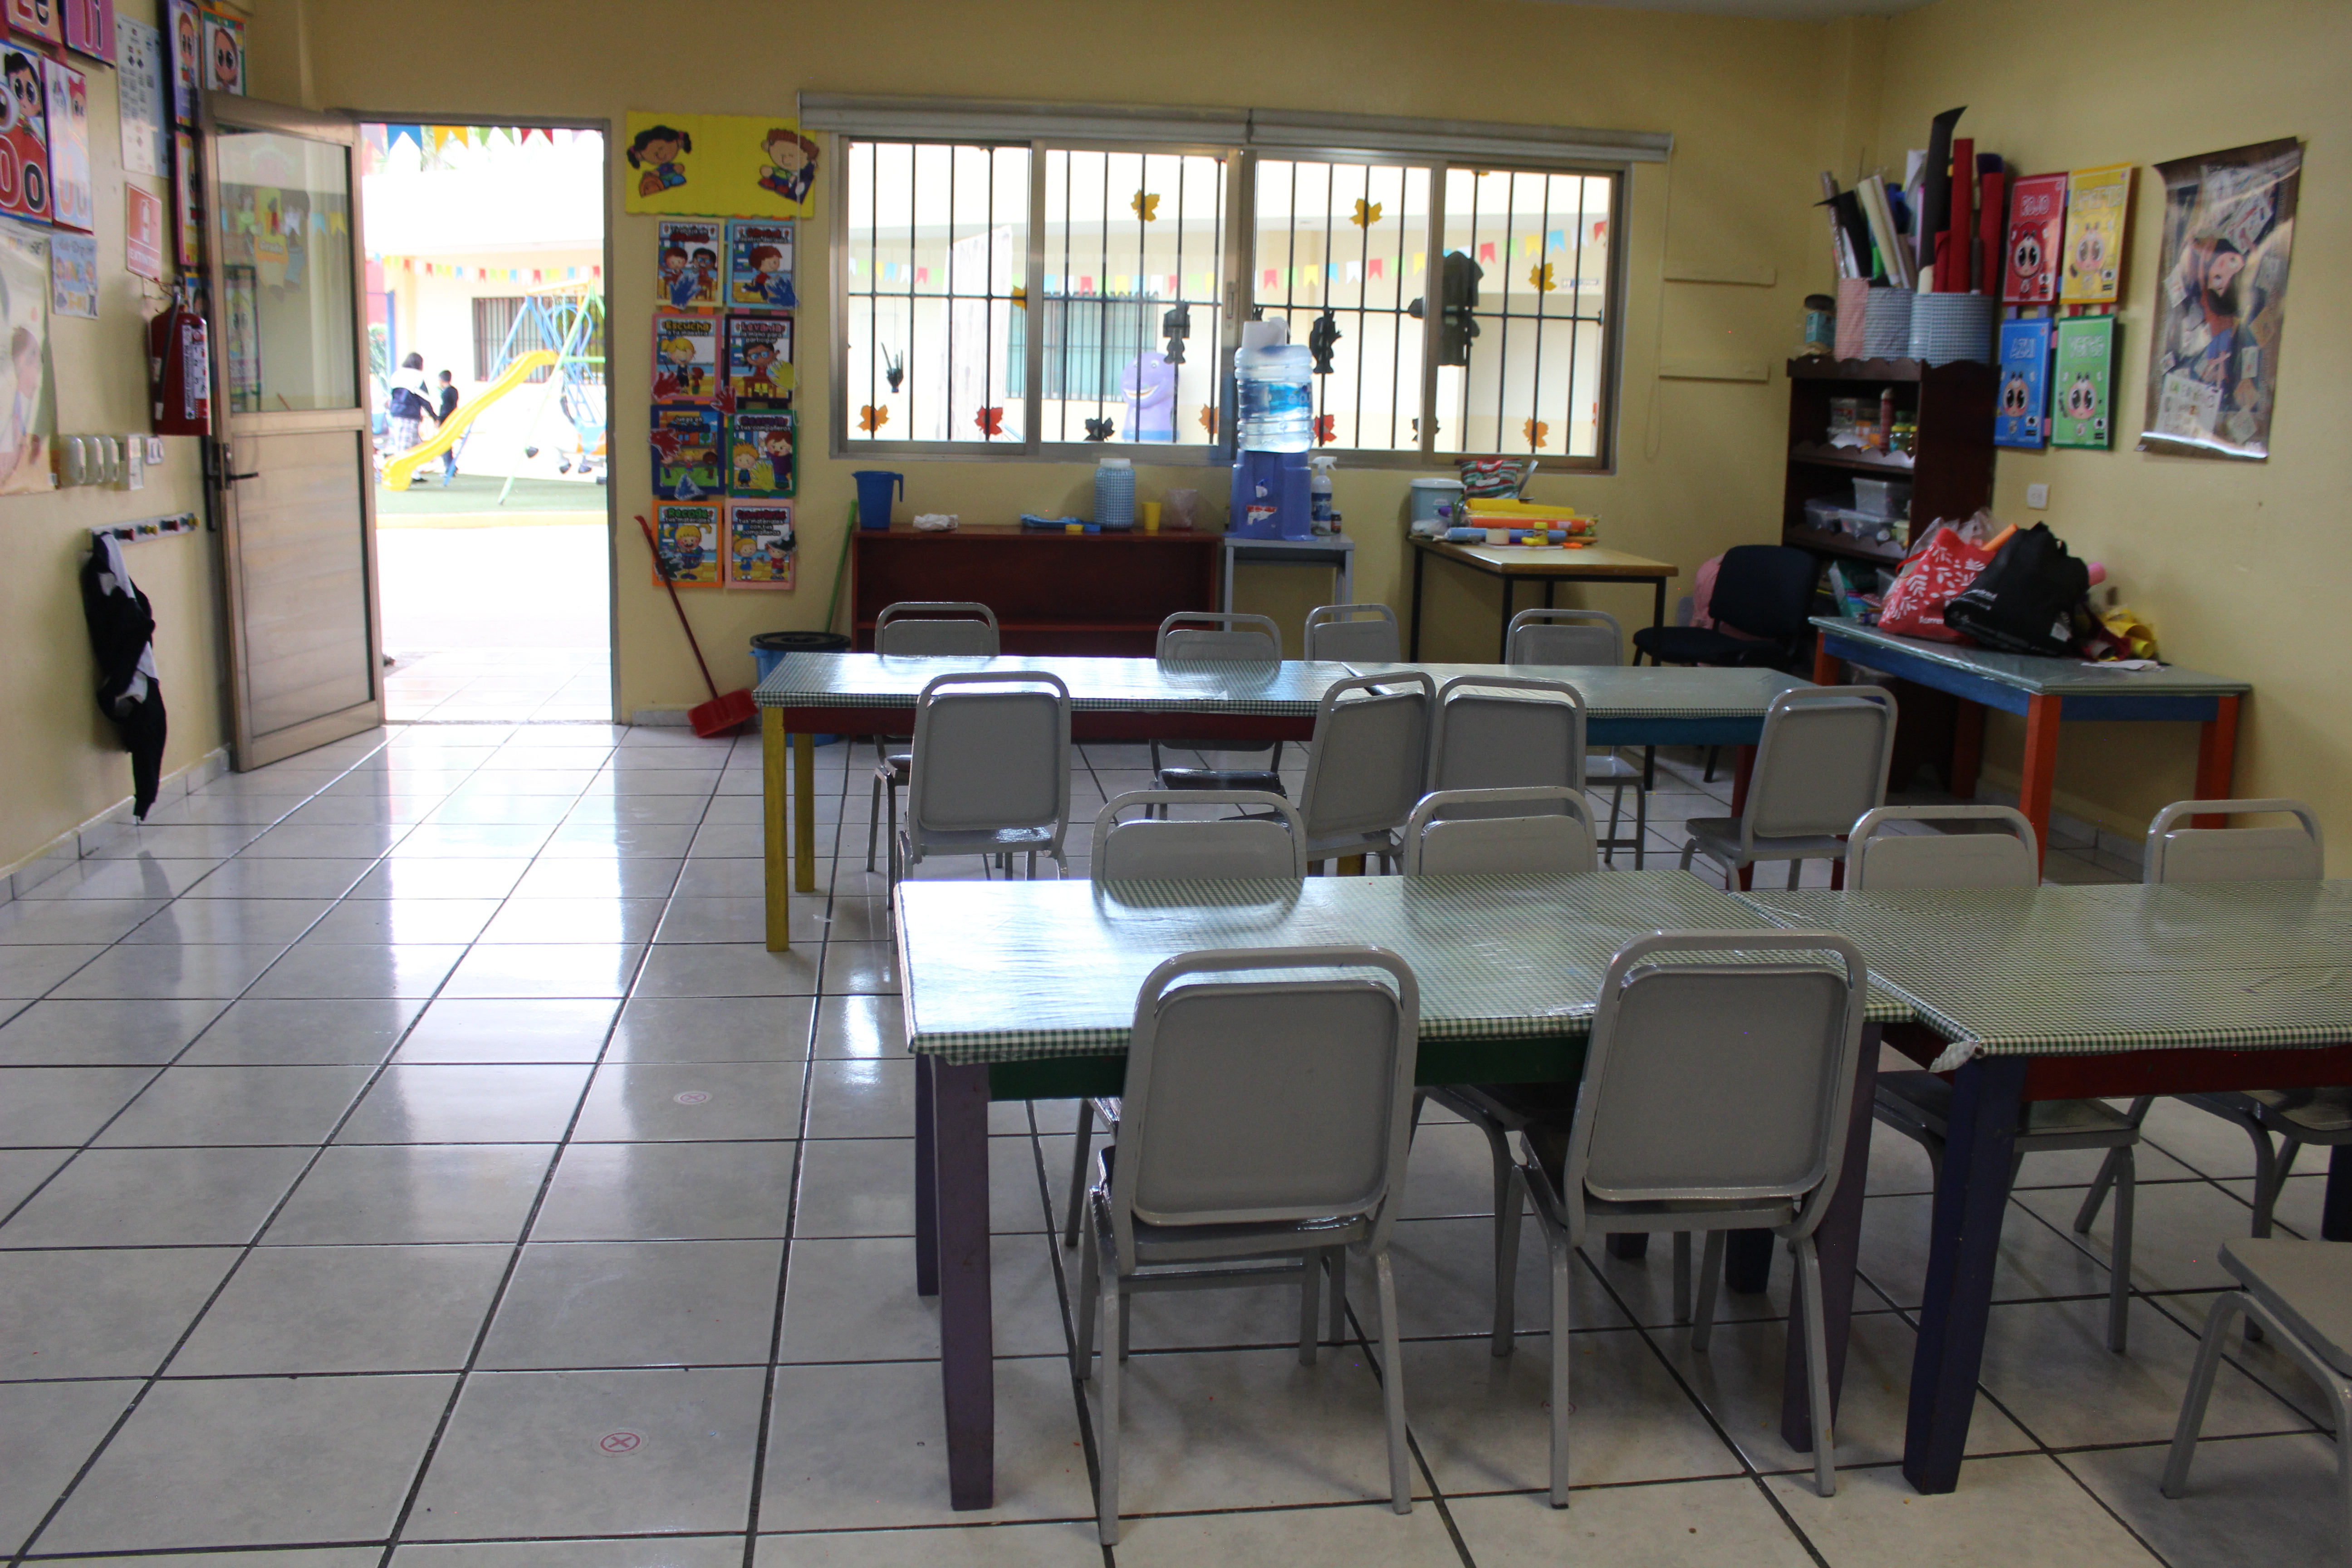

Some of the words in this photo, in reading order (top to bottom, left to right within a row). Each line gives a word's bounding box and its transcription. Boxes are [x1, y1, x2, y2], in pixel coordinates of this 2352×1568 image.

[665, 321, 710, 332] Escucha
[741, 322, 782, 332] Levanta
[668, 508, 708, 518] Recoge
